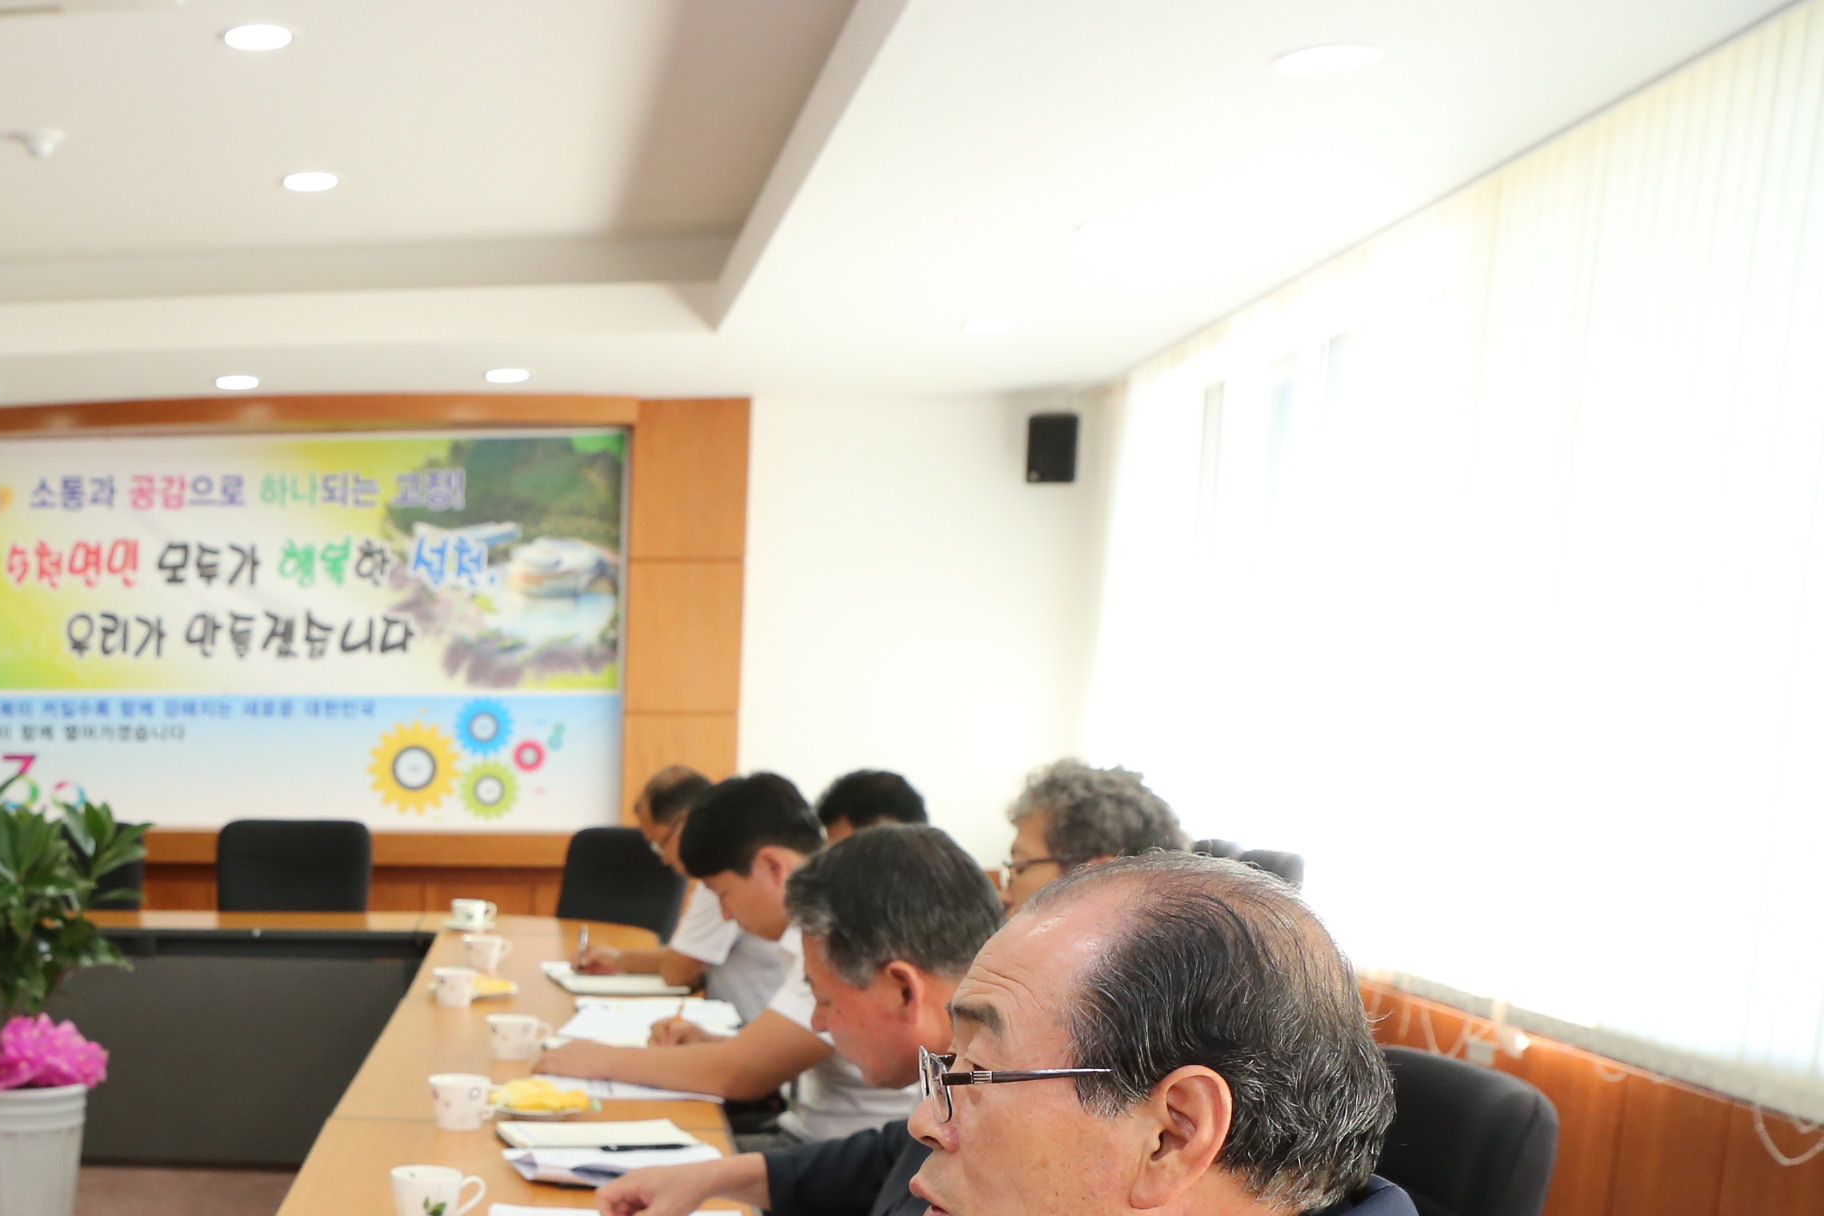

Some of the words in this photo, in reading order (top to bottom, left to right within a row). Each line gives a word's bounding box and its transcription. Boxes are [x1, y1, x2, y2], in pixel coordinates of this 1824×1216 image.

[30, 475, 116, 508] 소통과
[129, 474, 246, 509] 공감으로
[260, 473, 381, 508] 하나되는
[157, 543, 260, 586] 모두가
[279, 538, 394, 588] 행복한
[67, 612, 167, 657] 우리가
[185, 610, 416, 659] 만들겠습니다
[304, 701, 375, 718] 대한민국
